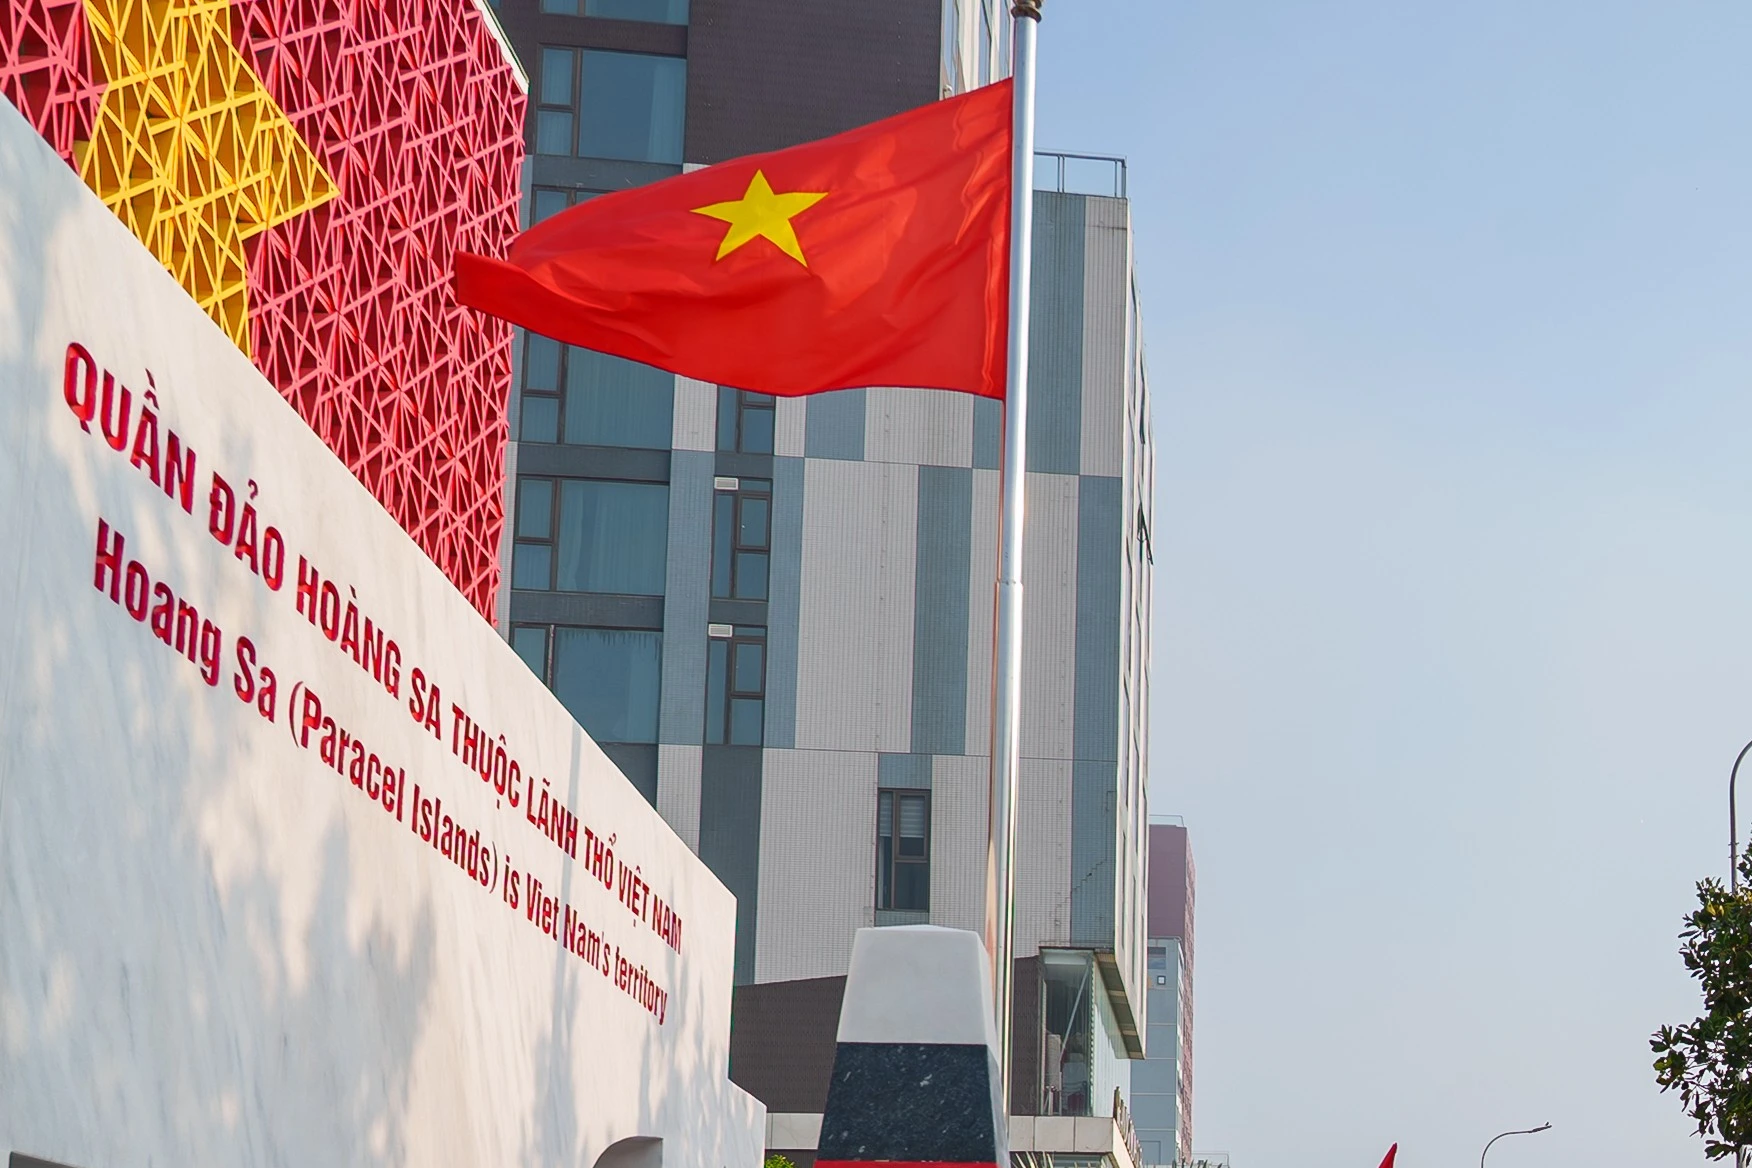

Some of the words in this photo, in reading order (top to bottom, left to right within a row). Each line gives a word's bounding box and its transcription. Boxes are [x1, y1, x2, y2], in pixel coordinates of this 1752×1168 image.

[63, 341, 196, 516] QUẦN
[209, 470, 285, 591] ĐẢO
[296, 554, 401, 701] HOÀNG
[409, 667, 441, 741] SA
[452, 702, 521, 810] THUỘC
[527, 776, 578, 860] LÃNH
[584, 832, 617, 891] THỔ
[618, 860, 651, 928] VIỆT
[652, 894, 682, 955] NAM
[94, 516, 222, 687] Hoang
[234, 636, 277, 724] Sa
[289, 681, 406, 823] (Paracel
[411, 783, 498, 894] Islands)
[503, 855, 520, 910] is
[526, 873, 560, 942] Viet
[562, 903, 611, 978] Nam's
[614, 946, 668, 1026] territory
